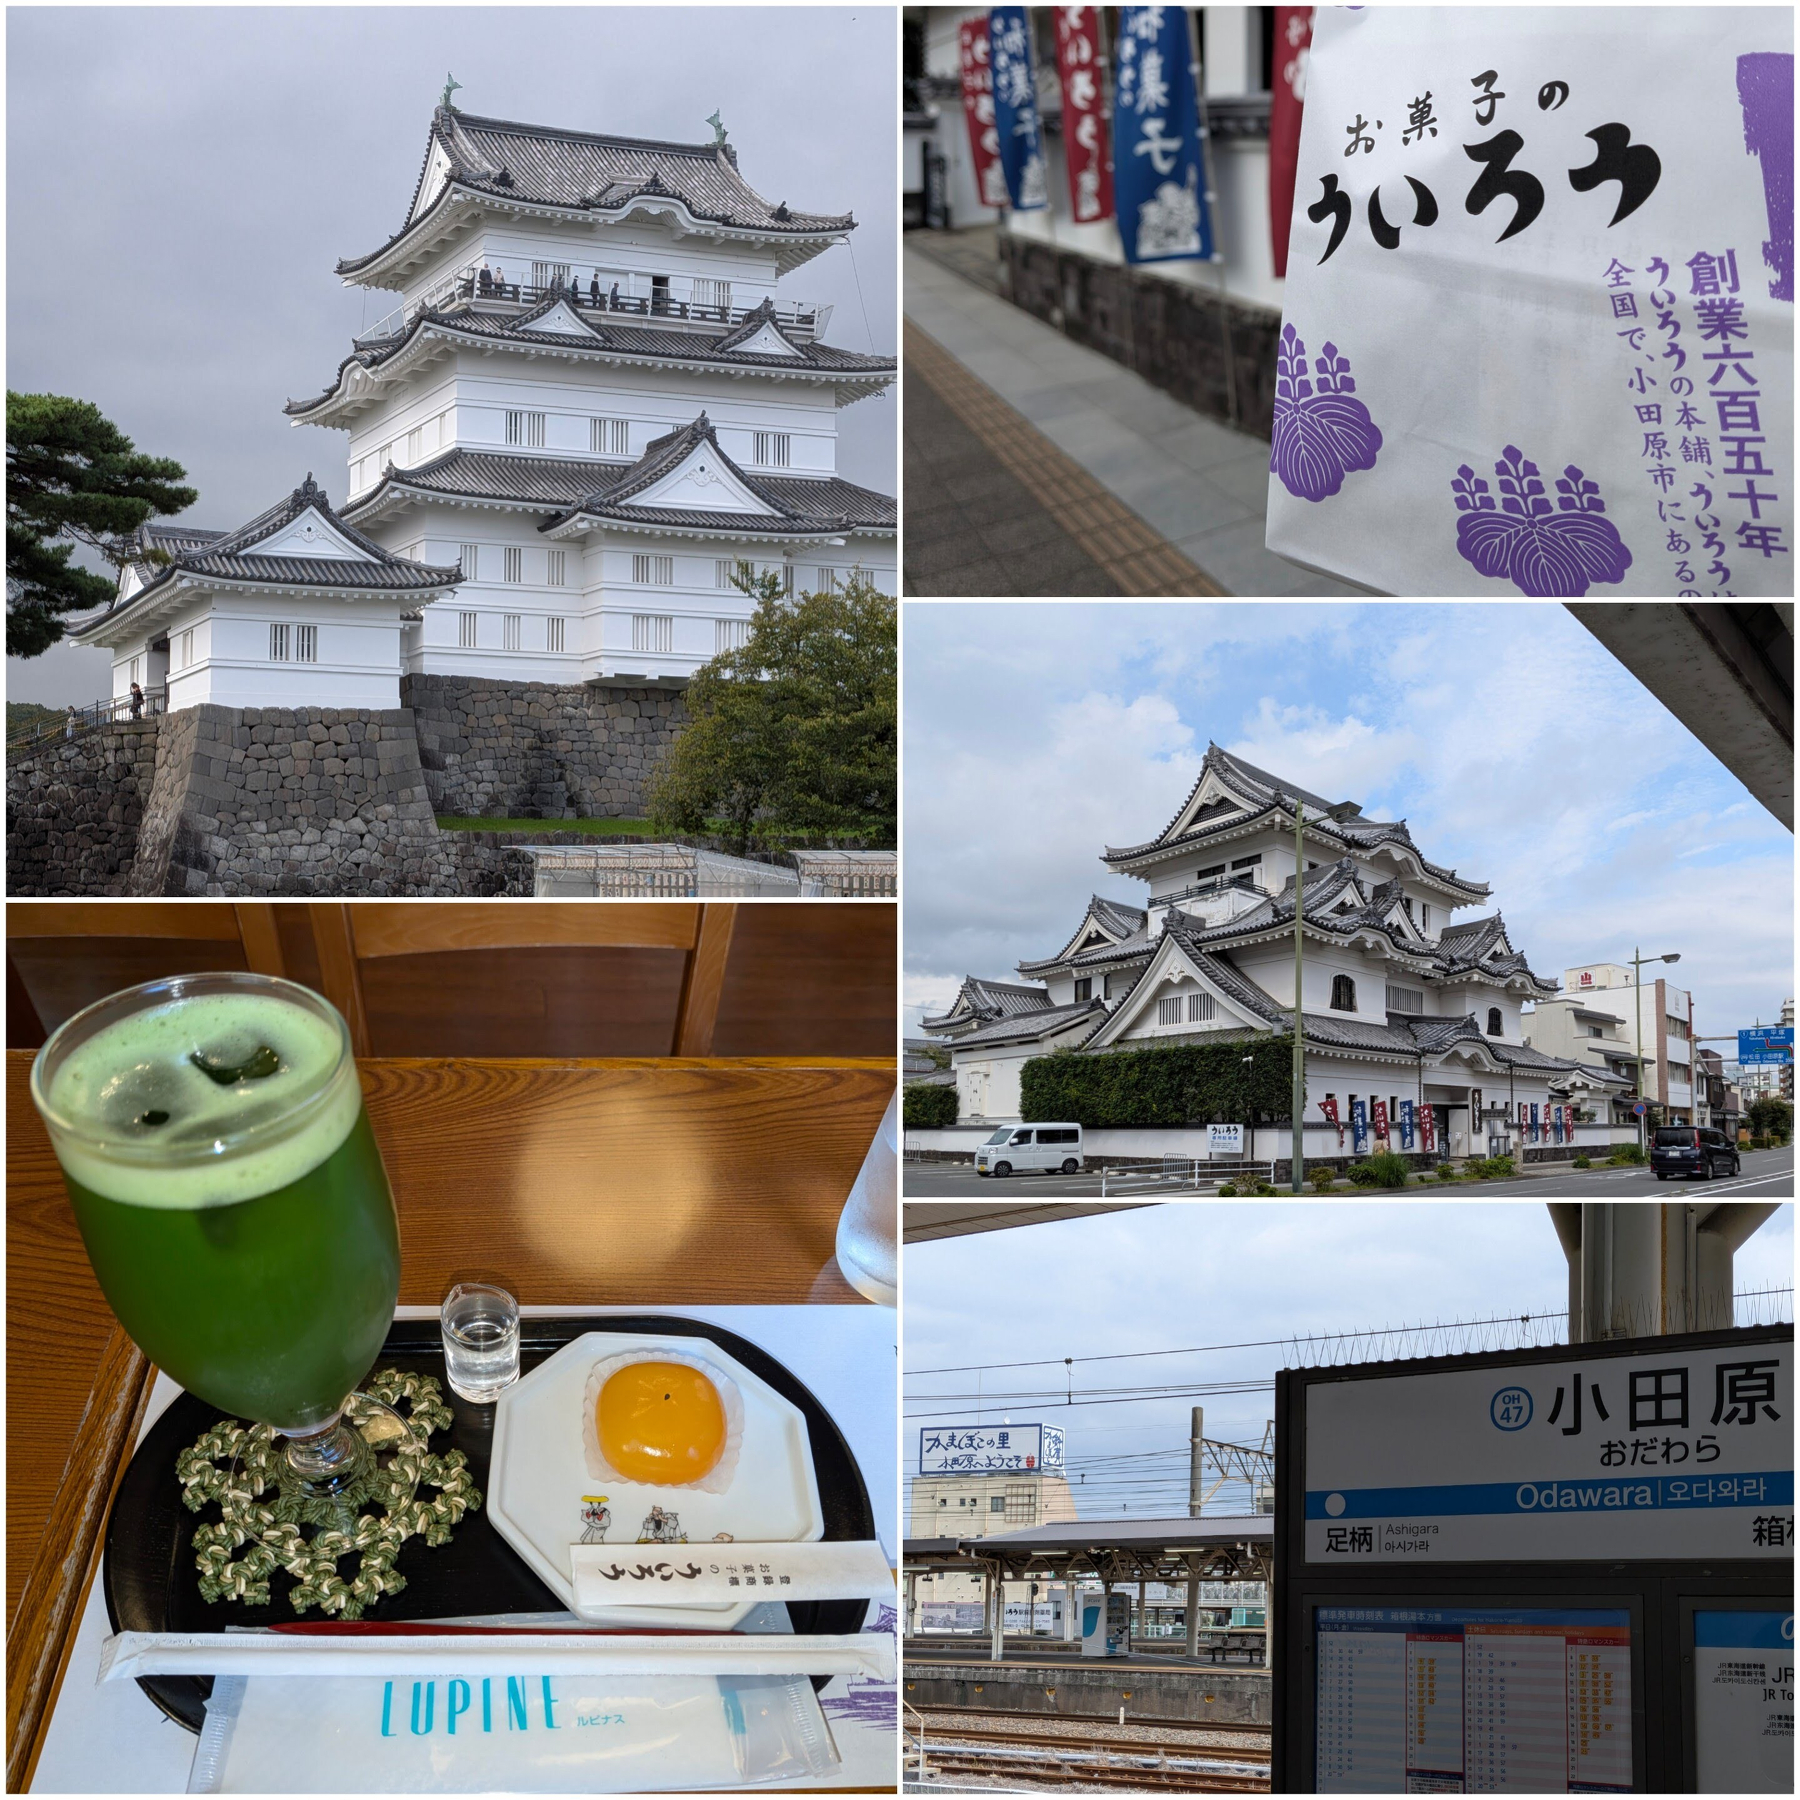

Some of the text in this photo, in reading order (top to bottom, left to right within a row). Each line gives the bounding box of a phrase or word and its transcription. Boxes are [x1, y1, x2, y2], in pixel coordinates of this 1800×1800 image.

[1344, 69, 1569, 157] お菓子の
[1307, 122, 1662, 266] ういろう
[1686, 248, 1788, 559] 創業六百五十年
[1212, 1126, 1238, 1135] ういろう
[1502, 1394, 1521, 1406] OH
[1546, 1359, 1781, 1436] 小田原
[1500, 1406, 1524, 1424] 47
[925, 1431, 1011, 1453] かまぼこの里
[1600, 1434, 1721, 1467] おだわら
[938, 1454, 1022, 1469] 小田原へようこそ
[1516, 1482, 1653, 1510] Odawara
[1666, 1477, 1767, 1504] 오다와라
[1325, 1525, 1373, 1554] 足柄
[1385, 1523, 1439, 1538] Ashigara
[1384, 1540, 1430, 1554] 아시가라
[598, 1562, 702, 1582] ういろう
[710, 1563, 770, 1574] お菓子の
[728, 1575, 790, 1586] 登録商標
[1763, 1689, 1776, 1702] JR
[381, 1676, 562, 1737] LUPINE
